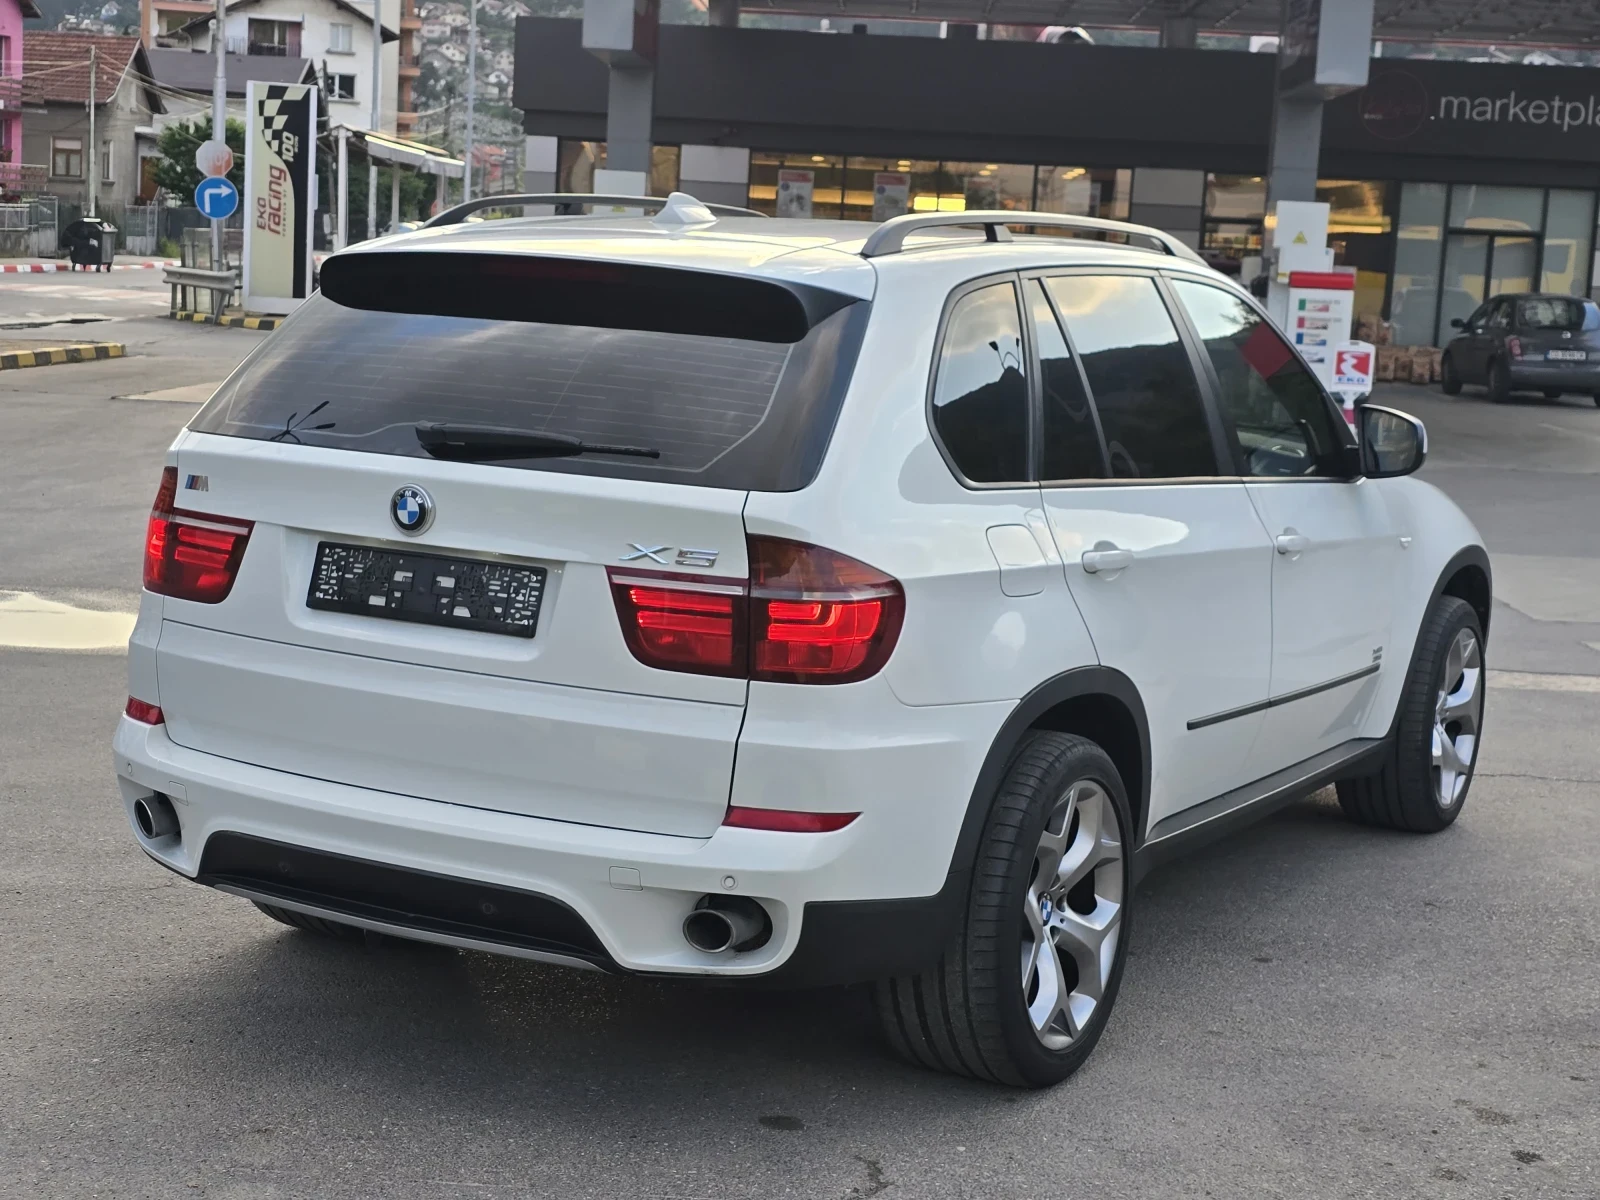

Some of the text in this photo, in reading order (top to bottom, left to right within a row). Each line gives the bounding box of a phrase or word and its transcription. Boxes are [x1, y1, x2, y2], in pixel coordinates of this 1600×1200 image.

[1429, 90, 1600, 132] .marketpl
[281, 131, 294, 162] 100
[256, 197, 267, 230] EKO
[268, 164, 287, 235] racing
[395, 490, 423, 504] BMW
[618, 543, 719, 568] X5
